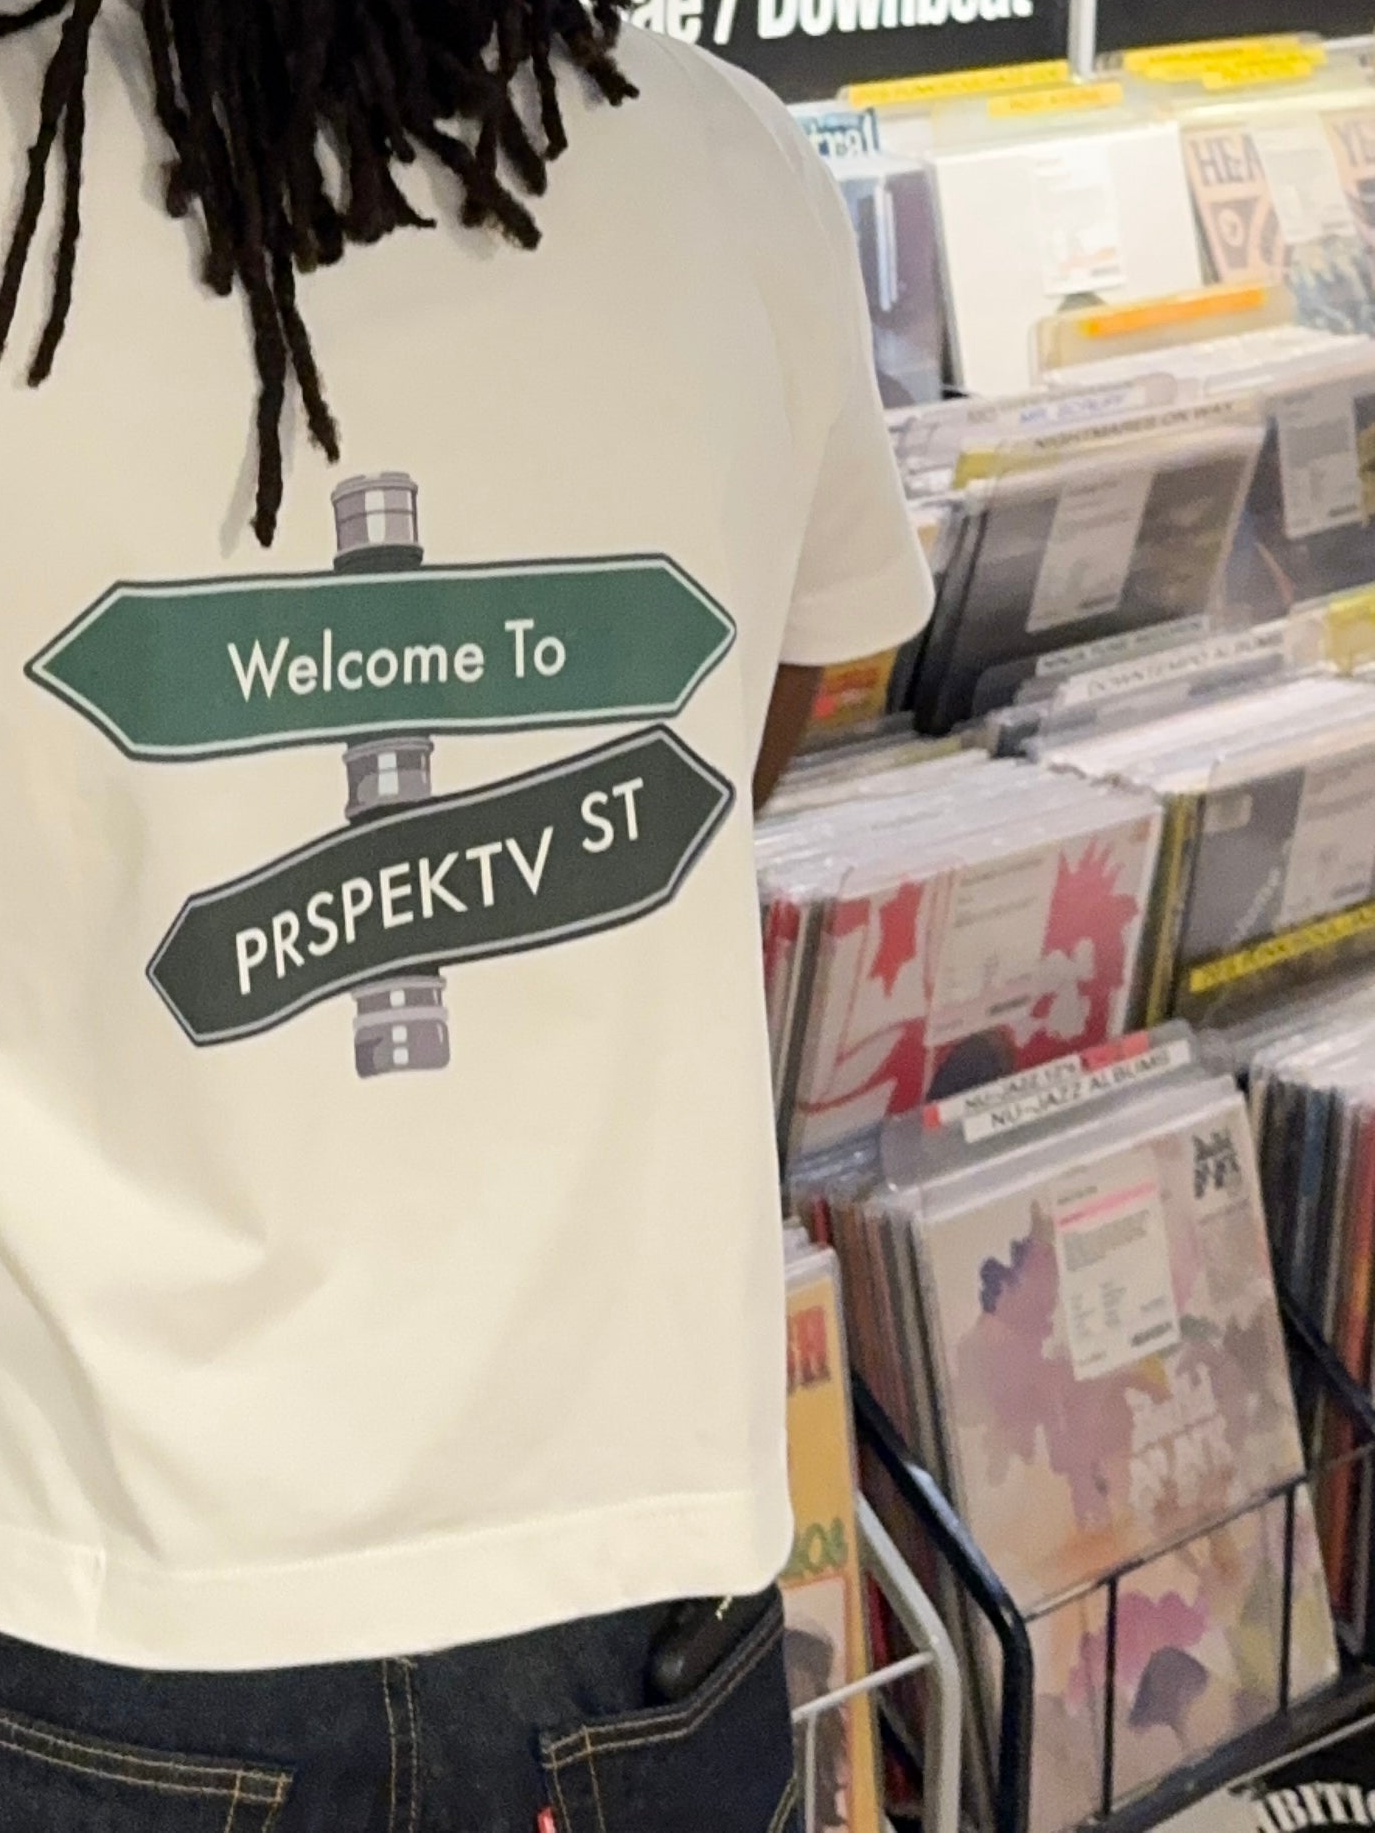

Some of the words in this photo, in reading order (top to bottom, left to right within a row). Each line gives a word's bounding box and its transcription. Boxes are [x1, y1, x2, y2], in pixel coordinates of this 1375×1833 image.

[227, 629, 486, 702] Welcome
[505, 618, 567, 679] To
[236, 827, 555, 995] PRSPEKTV
[581, 778, 644, 854] ST
